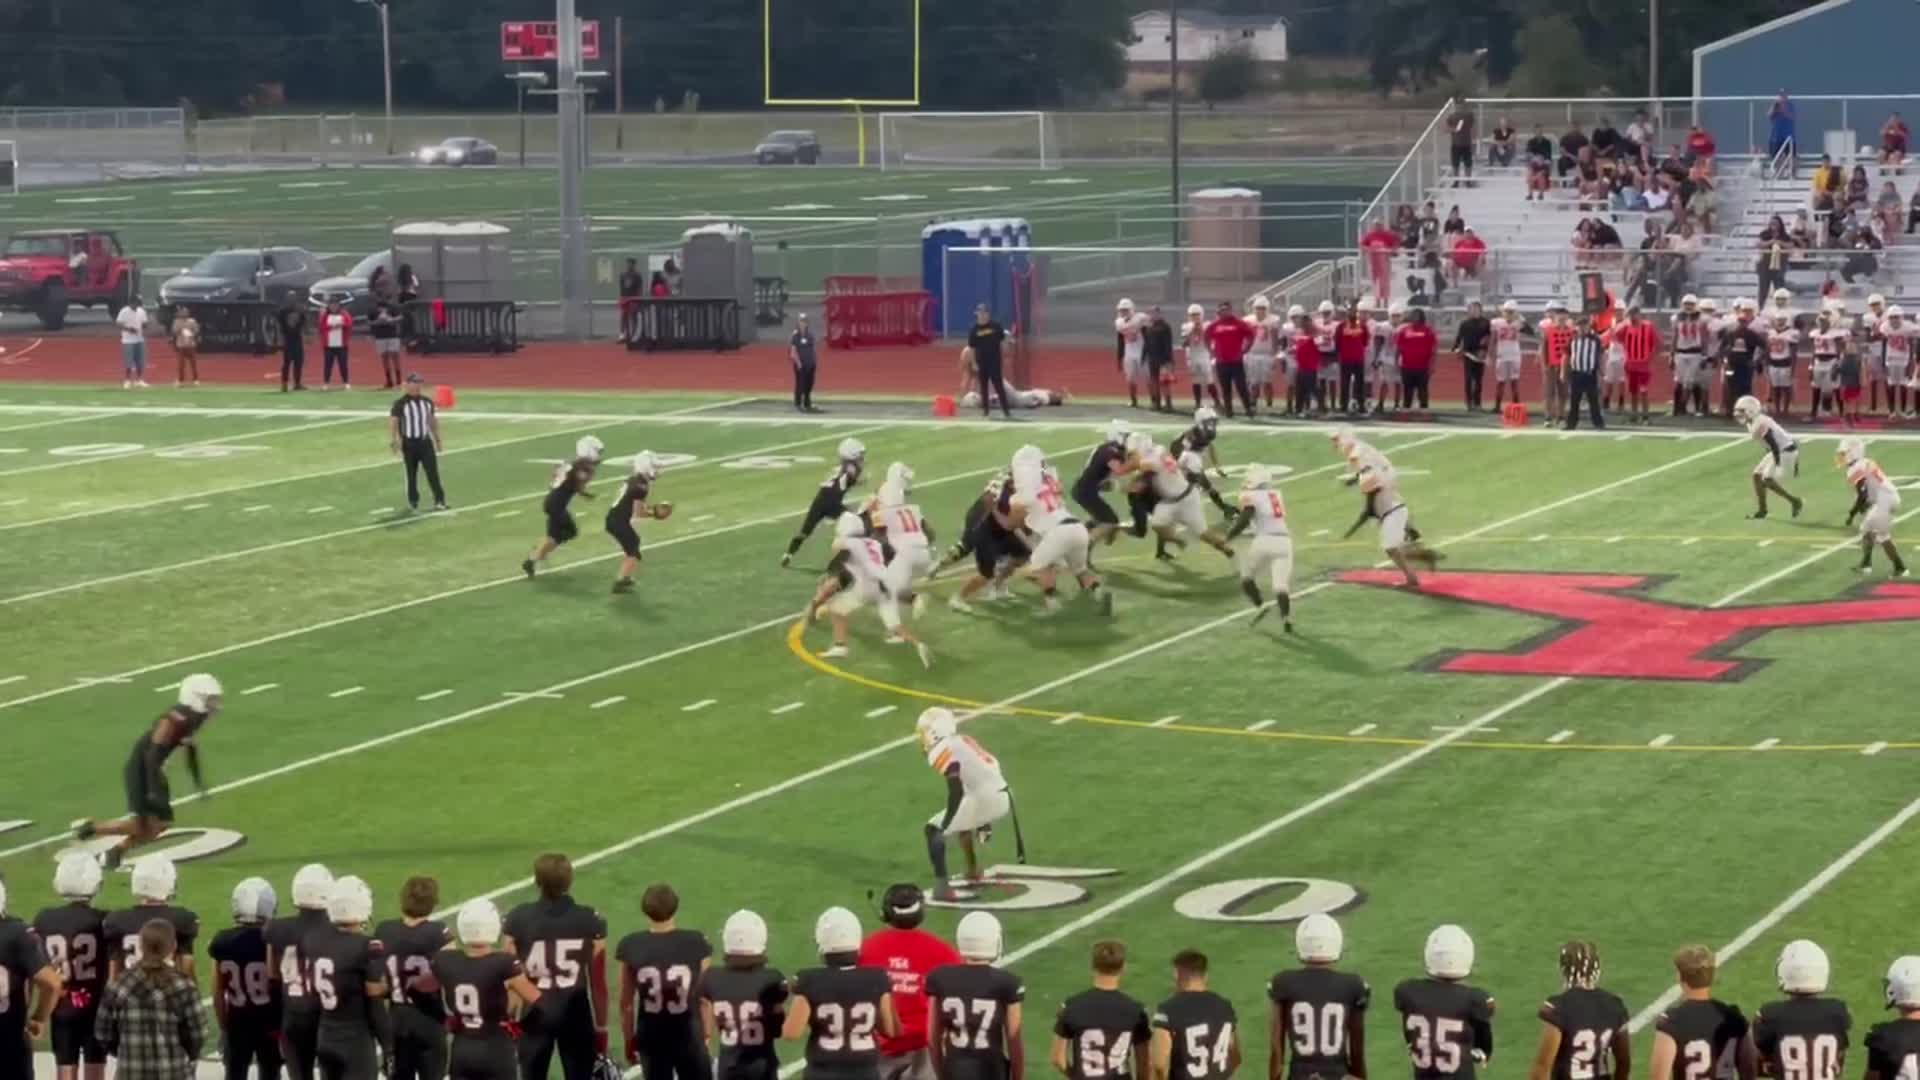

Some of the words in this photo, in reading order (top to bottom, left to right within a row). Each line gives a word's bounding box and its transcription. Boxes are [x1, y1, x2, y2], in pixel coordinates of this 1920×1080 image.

[219, 959, 271, 1008] 38
[525, 938, 584, 989] 45
[454, 983, 484, 1029] 9
[637, 964, 692, 1015] 33
[713, 1000, 764, 1047] 36
[816, 1002, 876, 1051] 32
[942, 996, 997, 1049] 37
[1290, 1001, 1345, 1057] 90
[1406, 1013, 1464, 1073] 35
[1079, 1028, 1132, 1078] 64
[1184, 1021, 1233, 1078] 54
